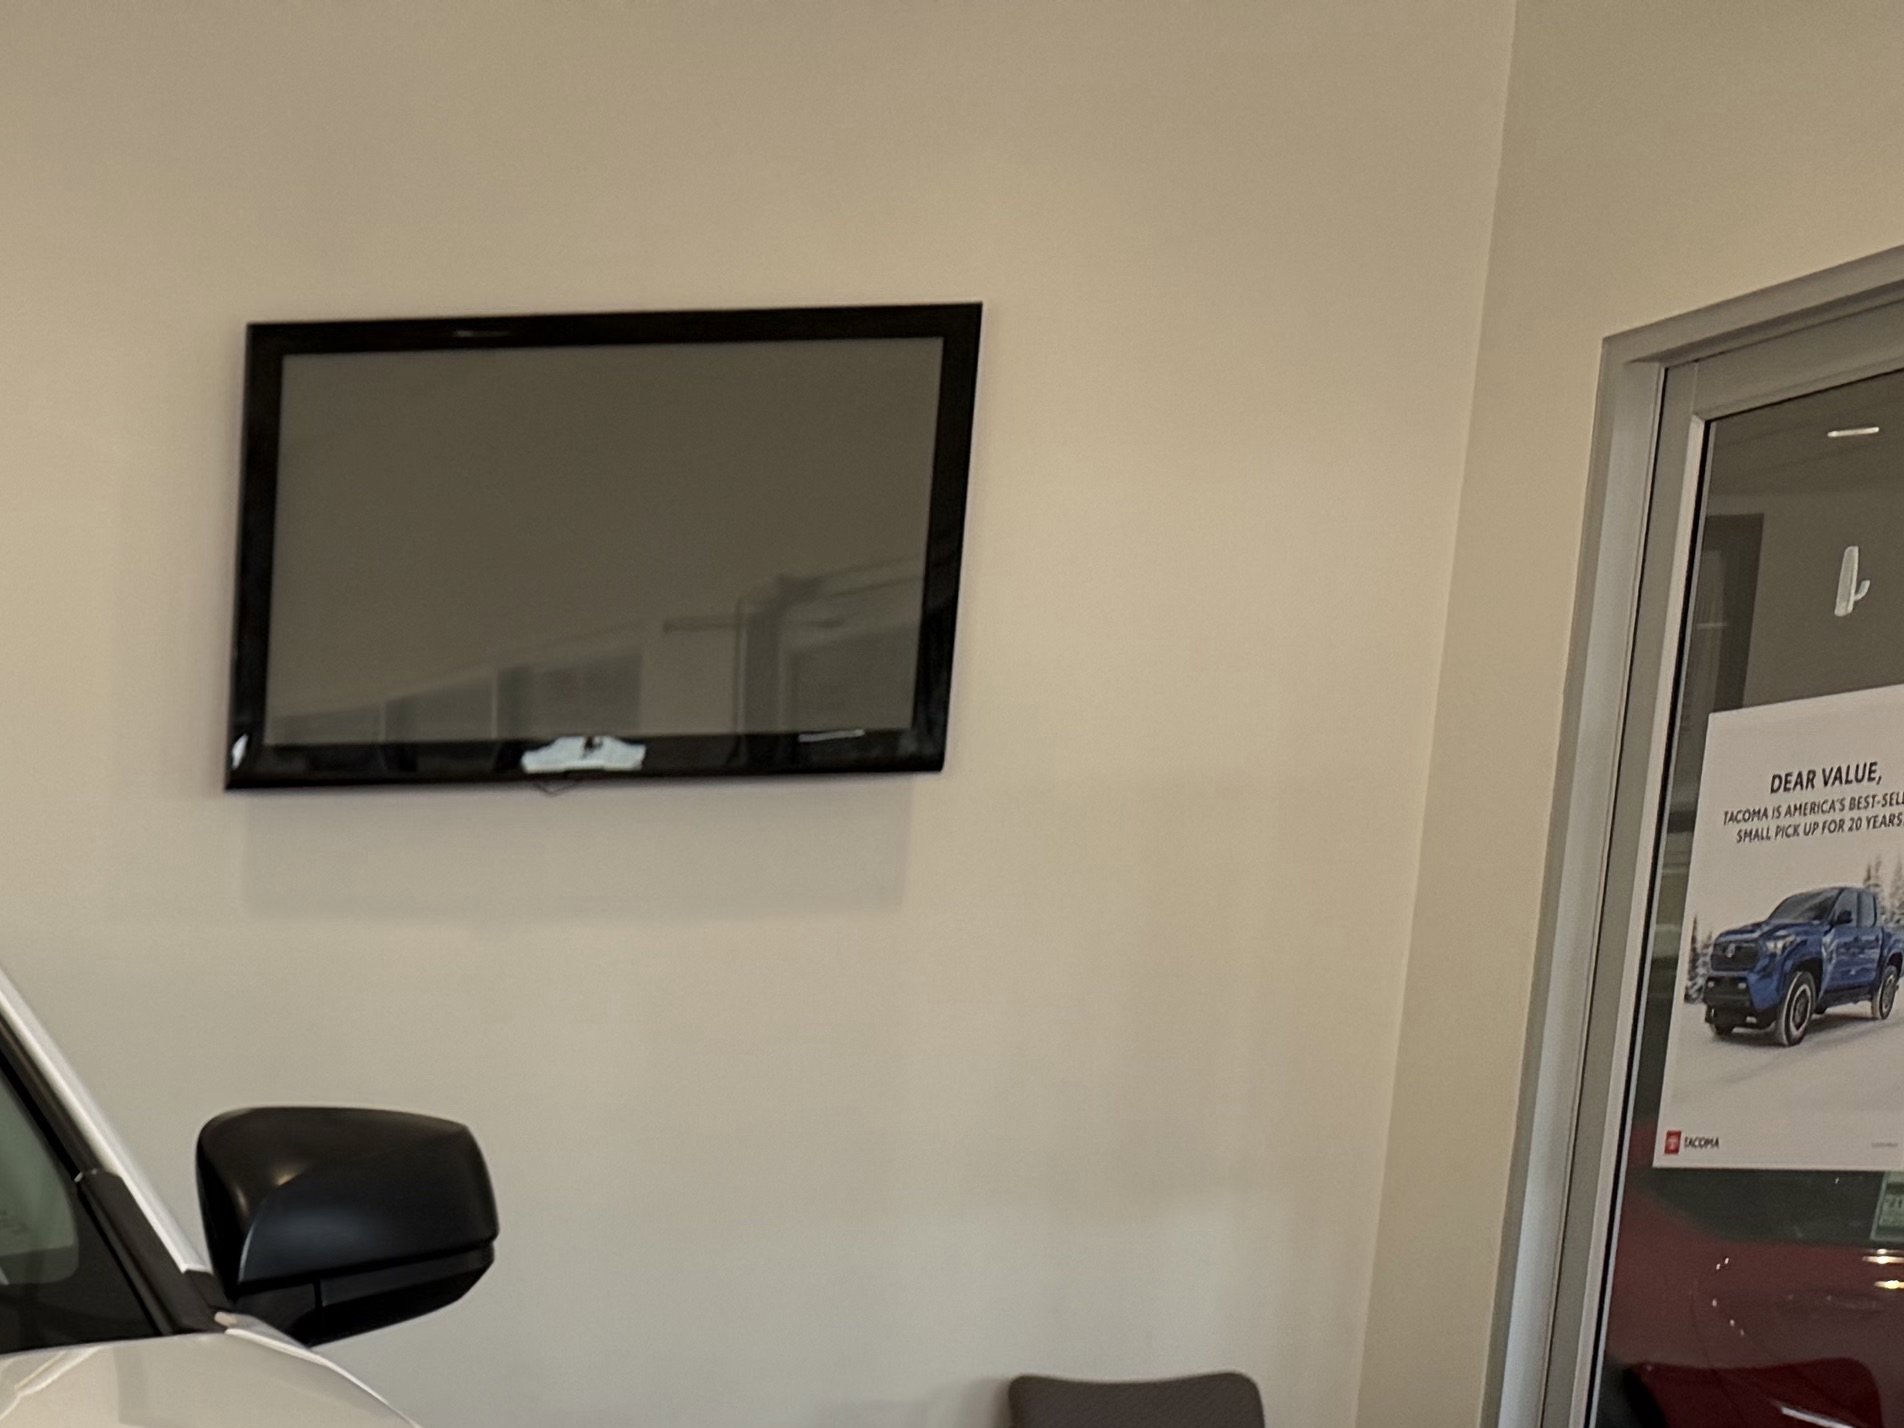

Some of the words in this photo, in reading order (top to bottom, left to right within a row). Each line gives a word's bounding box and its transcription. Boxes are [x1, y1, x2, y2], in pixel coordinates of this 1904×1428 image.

[1770, 768, 1816, 794] DEAR
[1822, 761, 1882, 787] VALUE,
[1723, 807, 1768, 825] TACOMA
[1771, 805, 1781, 820] IS
[1784, 797, 1846, 819] AMERICA'S
[1736, 829, 1771, 844] SMALL
[1775, 824, 1800, 840] PICK
[1803, 821, 1819, 837] UP
[1821, 819, 1845, 835] FOR
[1847, 816, 1862, 832] 20
